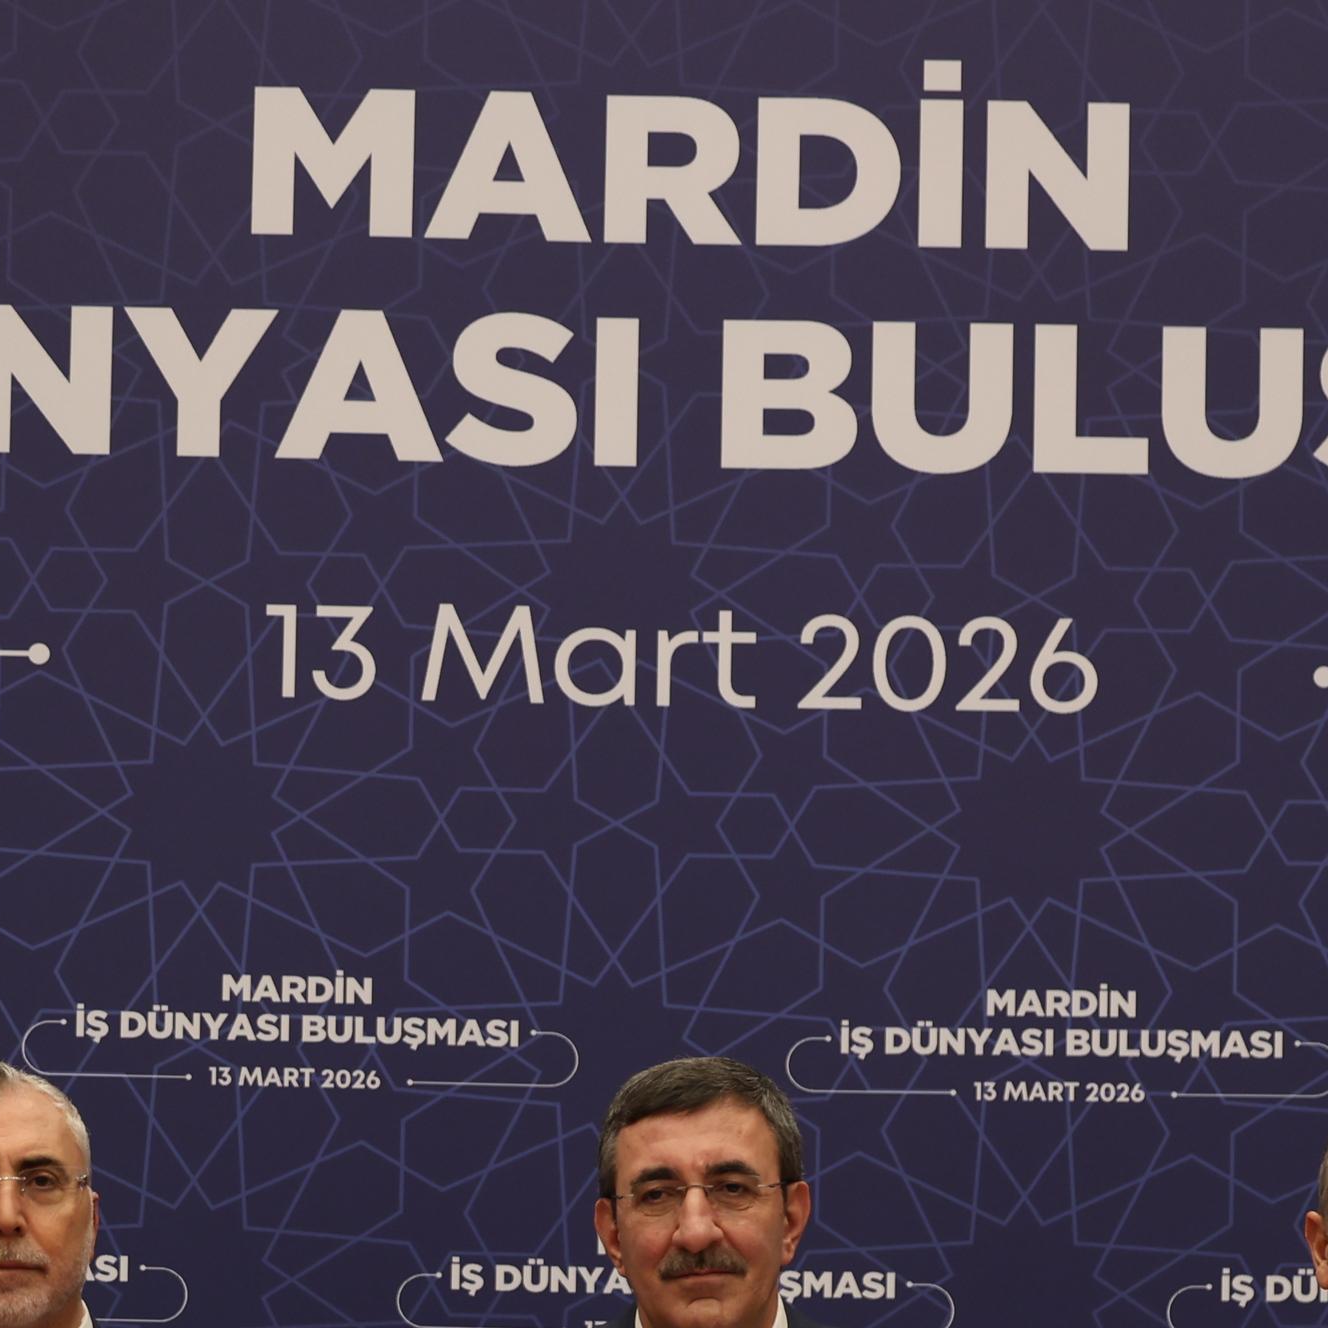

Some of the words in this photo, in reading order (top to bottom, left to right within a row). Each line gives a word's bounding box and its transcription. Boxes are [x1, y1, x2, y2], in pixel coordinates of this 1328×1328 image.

[250, 59, 1131, 252] MARDİN
[265, 604, 376, 701] 13
[421, 603, 757, 709] Mart
[797, 614, 1099, 714] 2026
[221, 969, 373, 1005] MARDİN
[986, 983, 1137, 1018] MARDİN
[75, 1003, 109, 1044] İŞ
[120, 1004, 290, 1042] DÜNYASI
[301, 1014, 519, 1051] BULUŞMASI
[840, 1019, 874, 1060] İŞ
[884, 1020, 1054, 1057] DÜNYASI
[1065, 1028, 1284, 1063] BULUŞMASI
[208, 1066, 232, 1086] 13
[238, 1066, 316, 1088] MART
[320, 1069, 381, 1090] 2026
[973, 1081, 997, 1101] 13
[1003, 1081, 1080, 1102] MART
[1085, 1082, 1146, 1103] 2026
[451, 1256, 484, 1297] İŞ
[495, 1258, 632, 1295] DÜNYA
[779, 1269, 897, 1304] ŞMASI
[1221, 1267, 1255, 1308] İŞ
